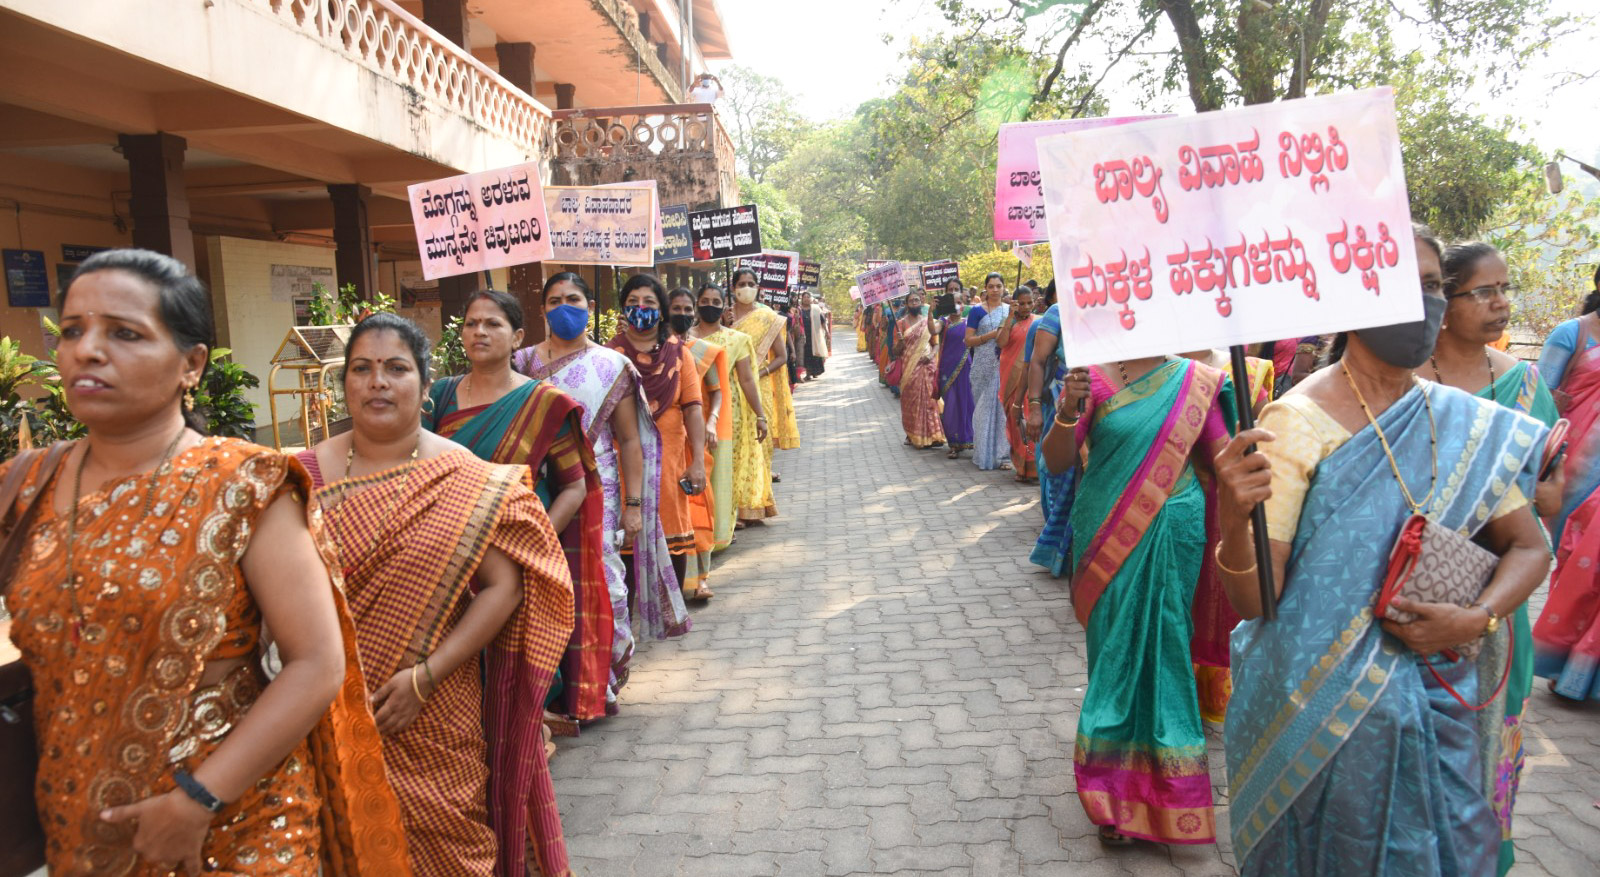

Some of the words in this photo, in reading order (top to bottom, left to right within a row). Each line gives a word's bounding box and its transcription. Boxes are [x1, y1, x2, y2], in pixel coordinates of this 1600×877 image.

[421, 185, 478, 228] ಮೊಗ್ಗನ್ನು
[480, 171, 531, 208] ಅರಳುವ
[1092, 153, 1169, 224] ಬಾಲ್ಯ
[1178, 128, 1264, 192] ವಿವಾಹ
[1278, 125, 1349, 194] ನಿಲ್ಲಿಸಿ
[561, 197, 581, 224] ಬಾಲ್ಯ
[585, 193, 632, 214] ವಿವಾಹವಾದರೆ
[1008, 204, 1047, 229] ಬಾಲ್ಯವ
[425, 225, 479, 267] ಮುನ್ನವೇ
[484, 217, 541, 254] ಚಿವುಟದಿರಿ
[1070, 244, 1153, 330] ಮಕ್ಕಳ
[1166, 225, 1320, 318] ಹಕ್ಕುಗಳನ್ನು
[1326, 218, 1400, 296] ರಕ್ಷಿಸಿ
